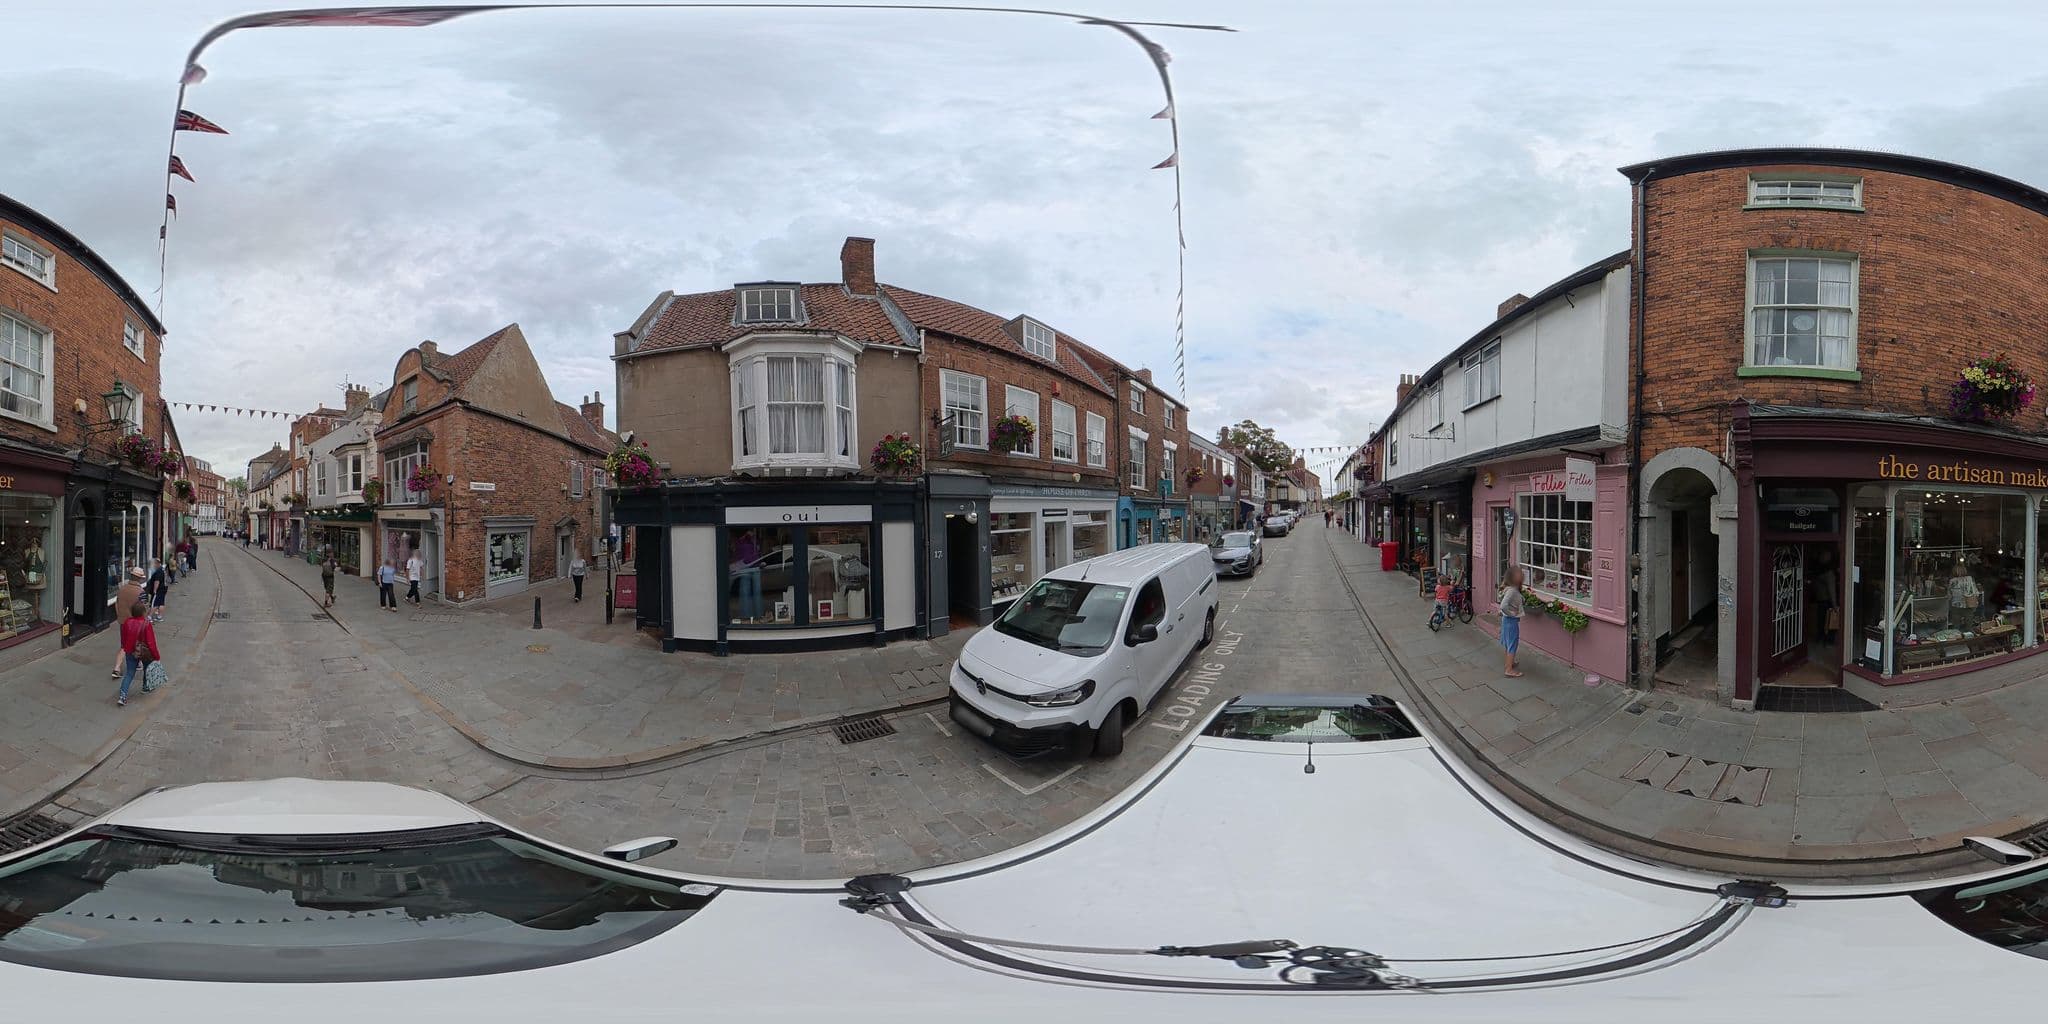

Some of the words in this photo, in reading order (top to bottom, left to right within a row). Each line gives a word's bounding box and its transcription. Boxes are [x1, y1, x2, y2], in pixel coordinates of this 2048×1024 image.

[1878, 454, 1919, 479] the
[1927, 461, 2005, 484] artisan
[2010, 468, 2048, 488] mak
[1042, 487, 1064, 496] HOUSE
[782, 506, 819, 521] oui
[1214, 630, 1244, 656] ONLY
[1151, 662, 1225, 732] LOADING
